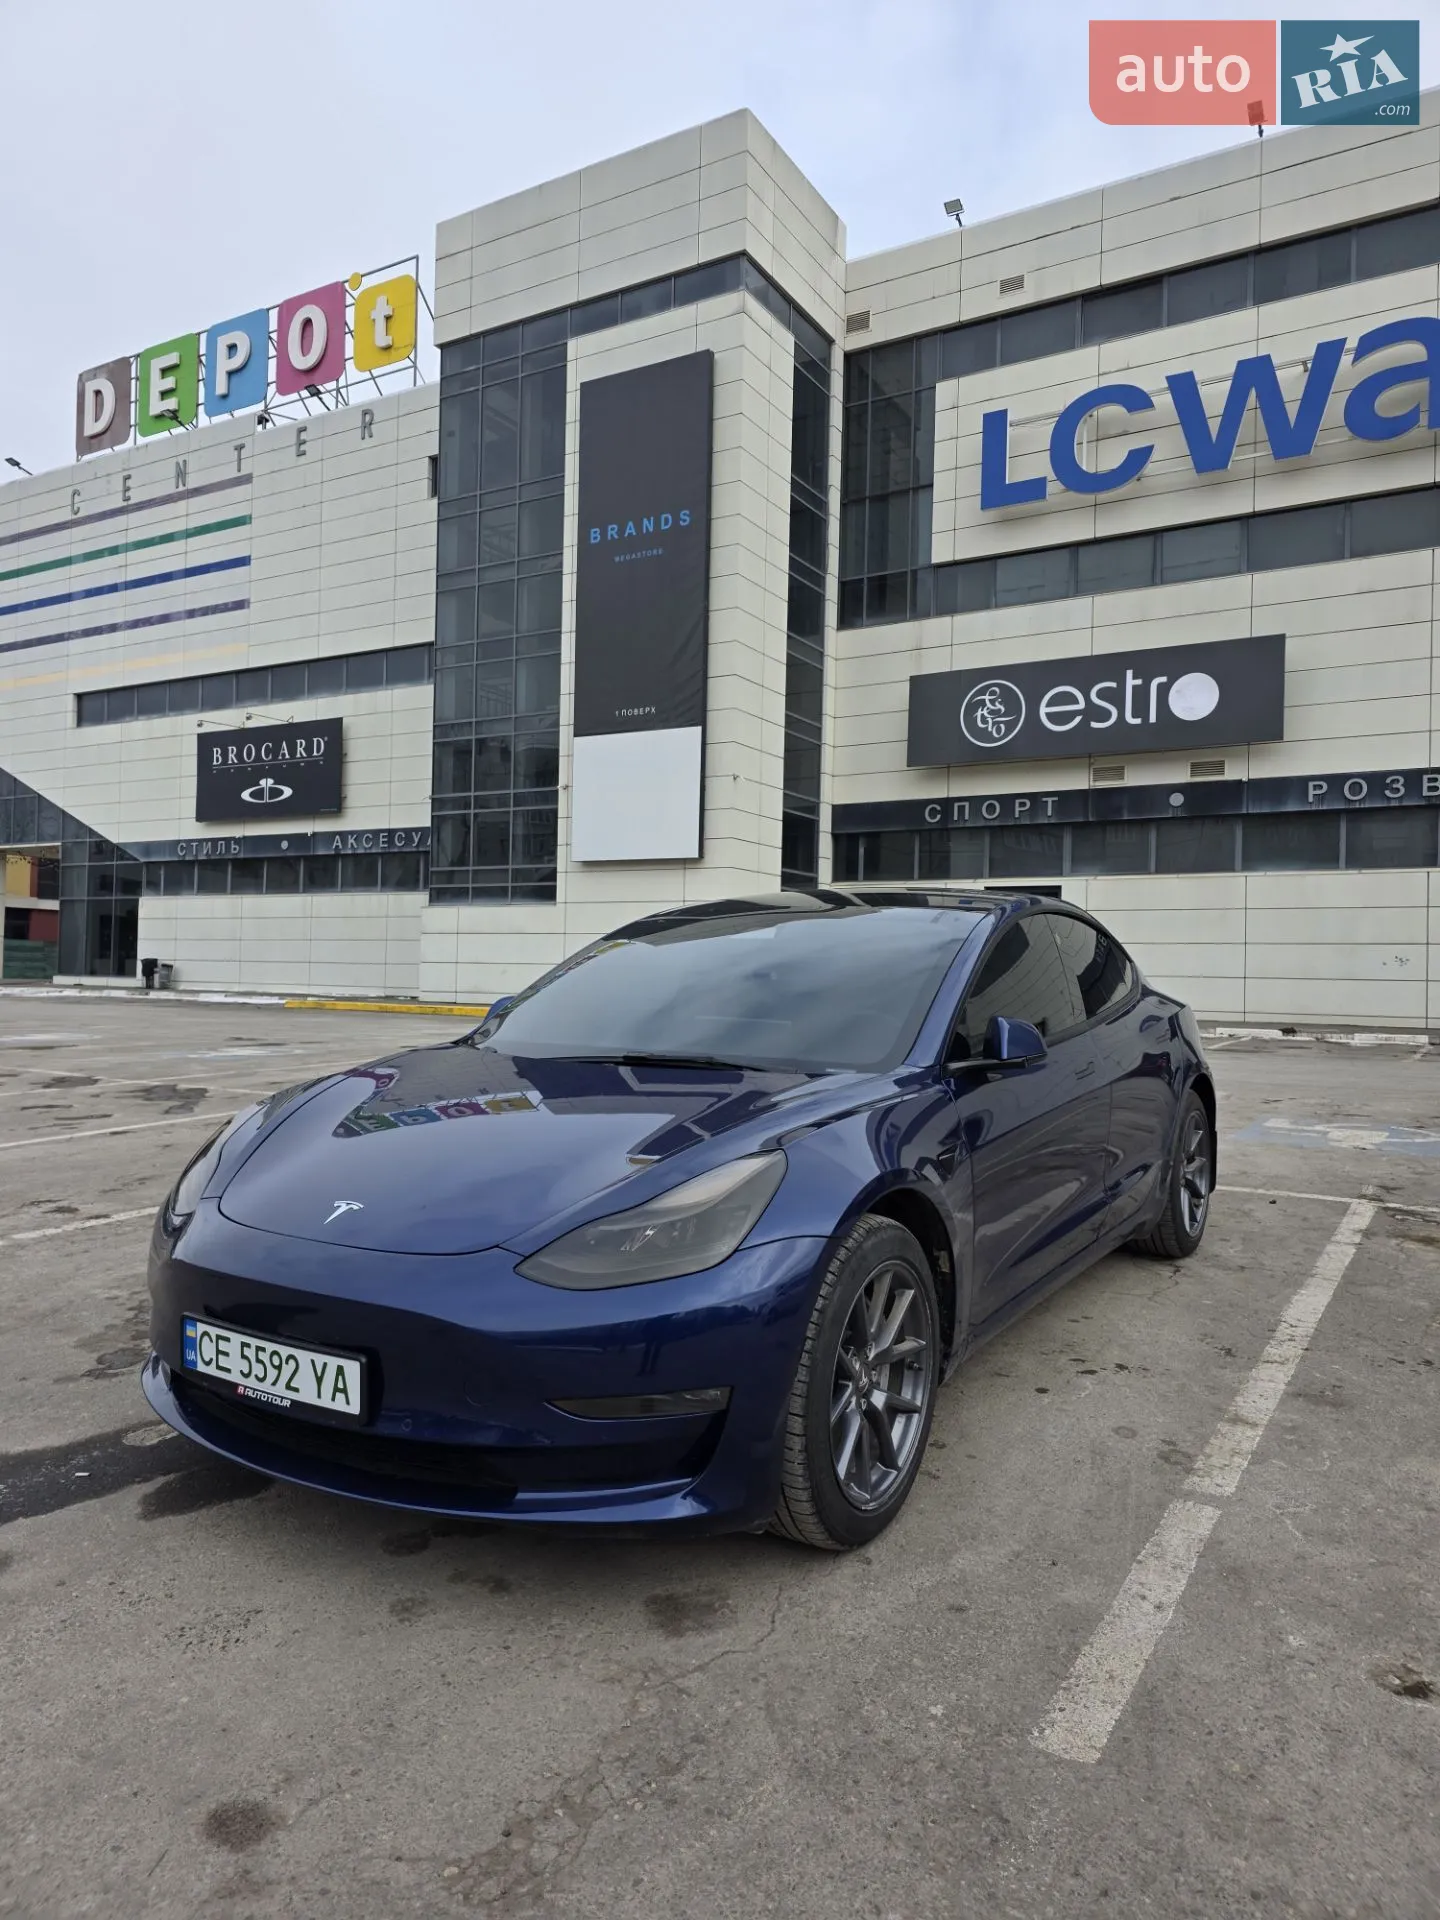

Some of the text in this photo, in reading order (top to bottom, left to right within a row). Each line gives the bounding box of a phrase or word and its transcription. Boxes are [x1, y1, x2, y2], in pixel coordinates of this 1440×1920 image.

[70, 408, 375, 517] CENTER
[590, 509, 690, 544] BRANDS
[621, 706, 656, 717] ПОВЕРХ
[1039, 669, 1220, 732] estro
[212, 737, 325, 766] BROCARD
[924, 796, 1059, 823] СПОРТ
[177, 840, 240, 856] СТИЛЬ
[186, 1348, 197, 1362] UA
[199, 1330, 351, 1406] CE 5592 YA
[244, 1388, 291, 1408] AUTOTOUR
